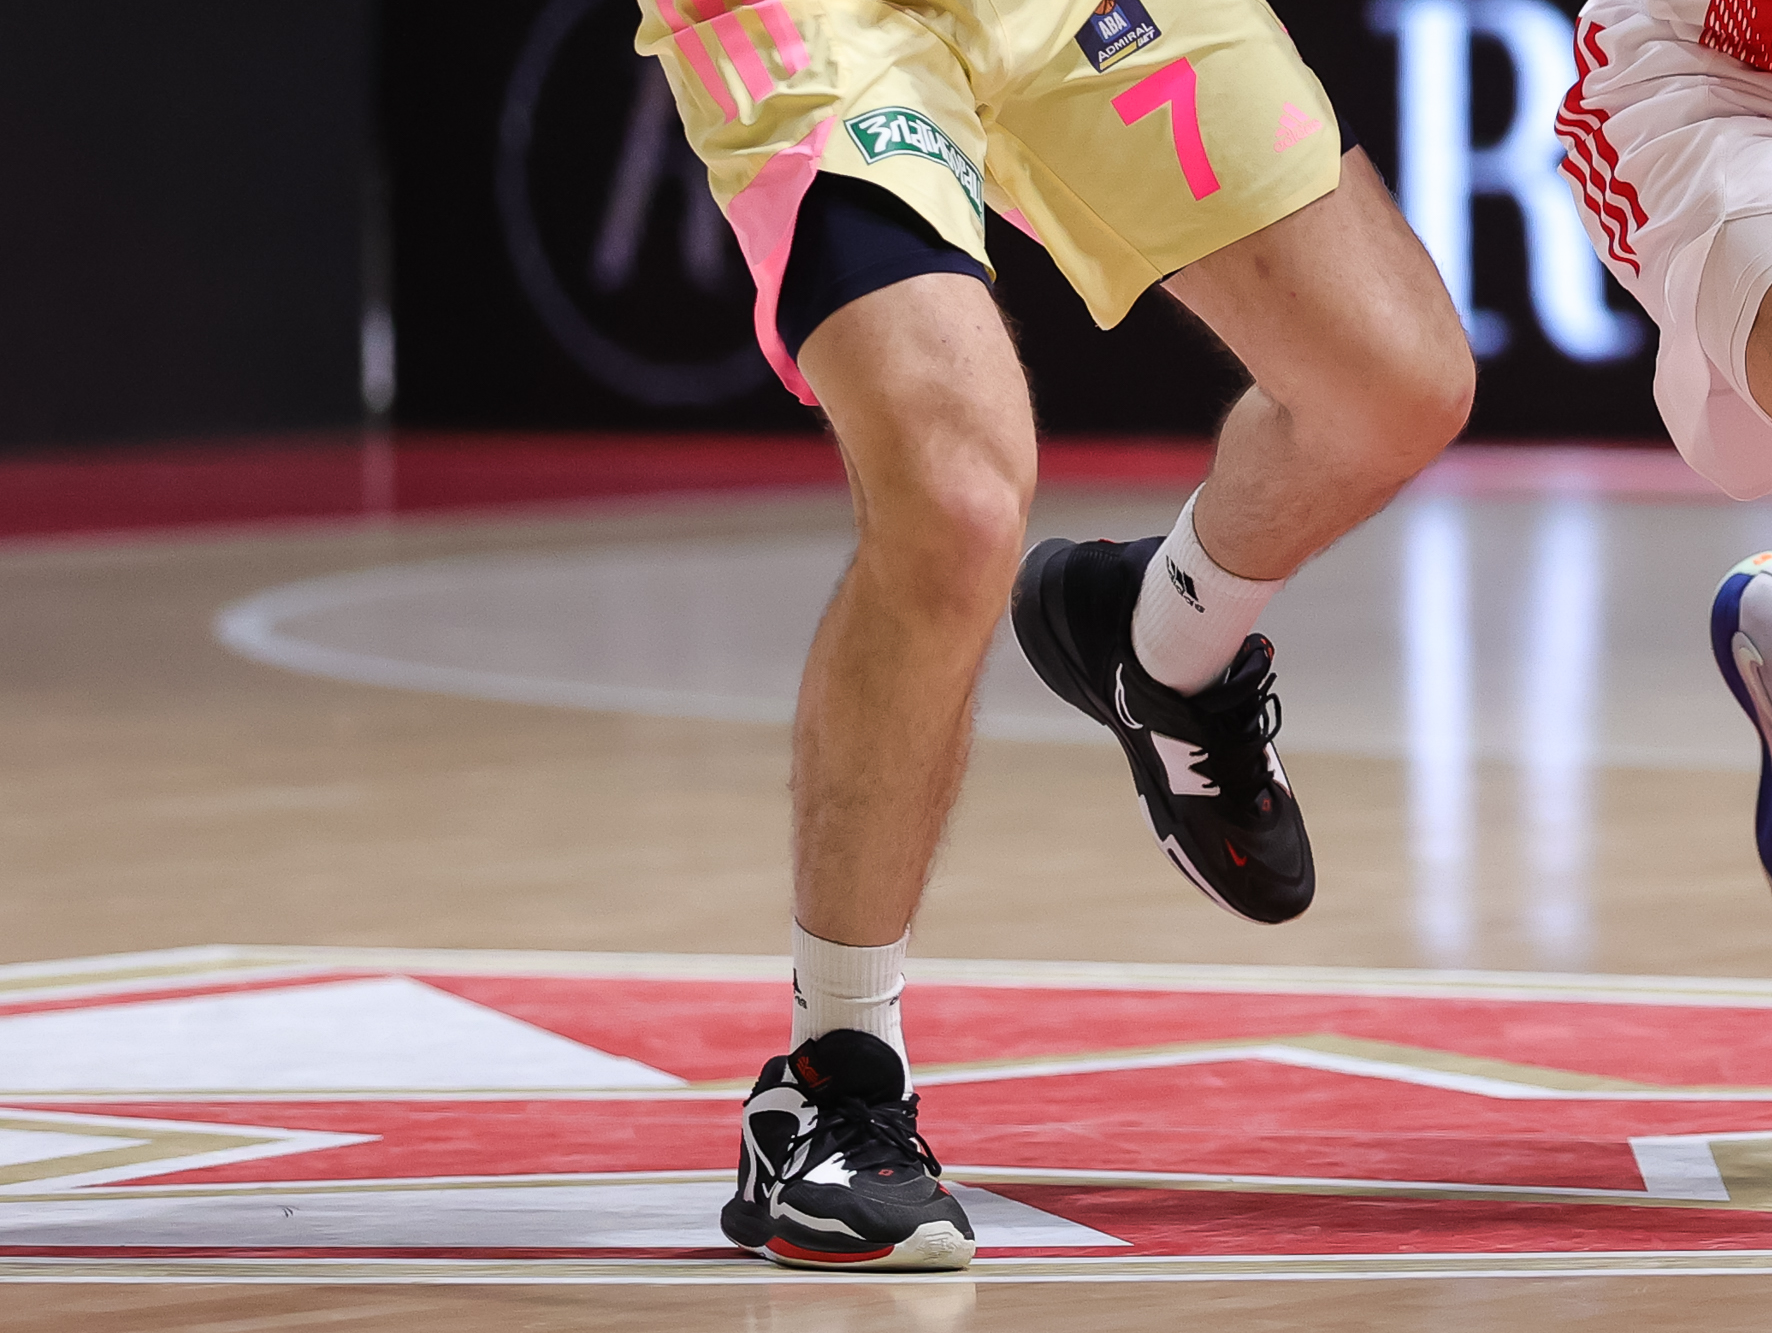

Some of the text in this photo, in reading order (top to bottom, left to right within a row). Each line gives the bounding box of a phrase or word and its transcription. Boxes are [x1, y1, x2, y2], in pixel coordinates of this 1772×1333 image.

[1097, 12, 1128, 39] ABA
[1097, 22, 1154, 62] ADMIRAL
[1110, 56, 1221, 201] 7
[1273, 119, 1322, 153] adidas
